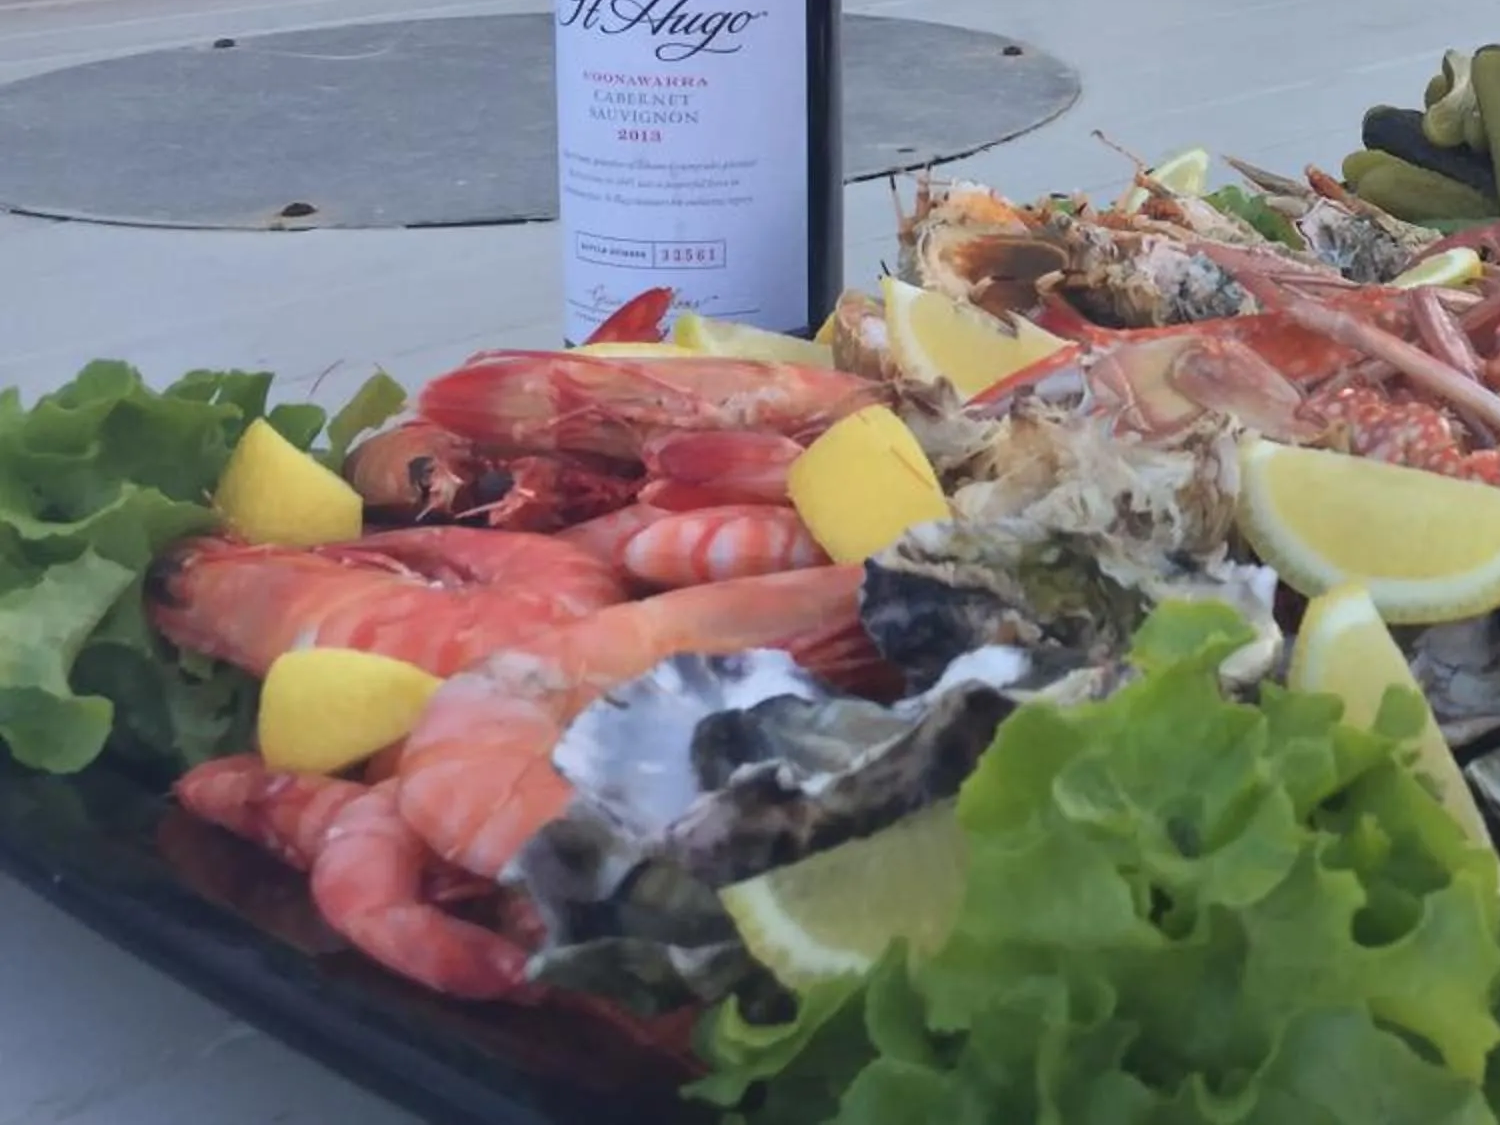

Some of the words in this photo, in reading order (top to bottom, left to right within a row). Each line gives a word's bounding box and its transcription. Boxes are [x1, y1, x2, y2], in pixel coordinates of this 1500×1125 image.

[593, 90, 690, 106] CABERNET
[589, 106, 699, 123] SAUVIGNON
[618, 129, 662, 142] 2013
